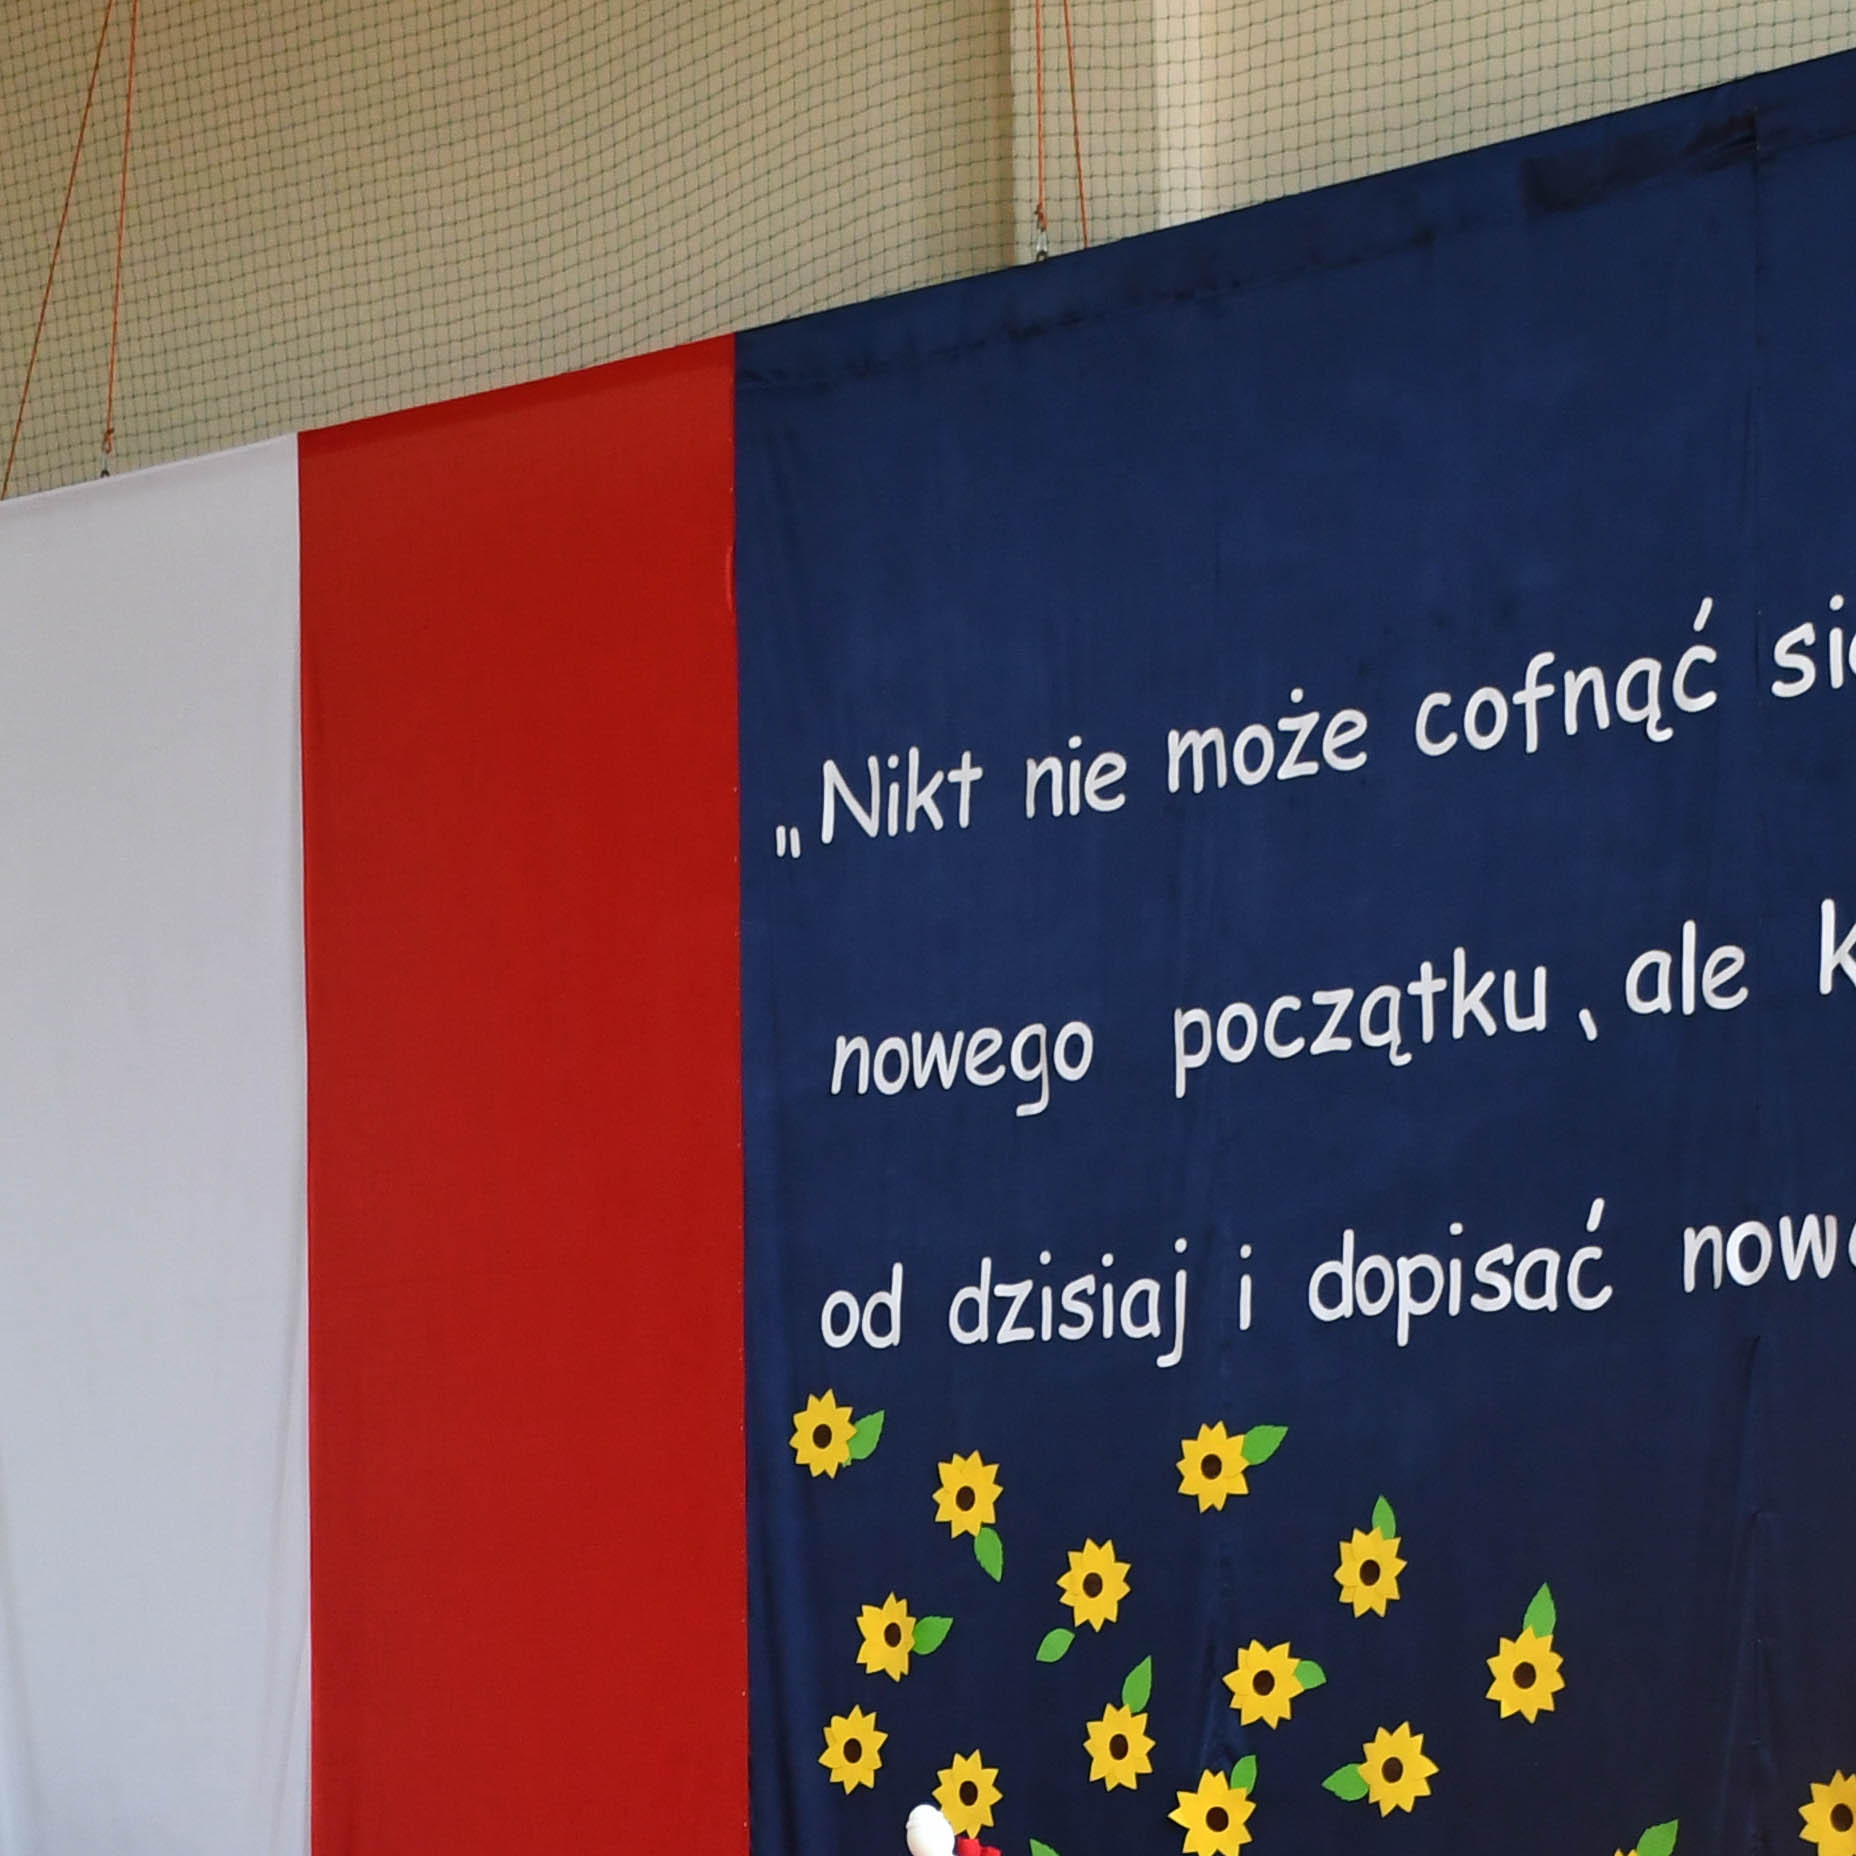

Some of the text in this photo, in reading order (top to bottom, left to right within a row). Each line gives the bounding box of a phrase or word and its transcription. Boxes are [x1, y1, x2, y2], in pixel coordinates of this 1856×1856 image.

[1025, 736, 1127, 819] nie
[1167, 688, 1368, 794] może
[1415, 597, 1718, 757] cofnąć
[831, 1020, 1094, 1117] nowego
[821, 1262, 904, 1349] od
[948, 1238, 1187, 1368] dzisiaj
[1239, 1243, 1252, 1331] i
[1308, 1197, 1613, 1347] dopisać
